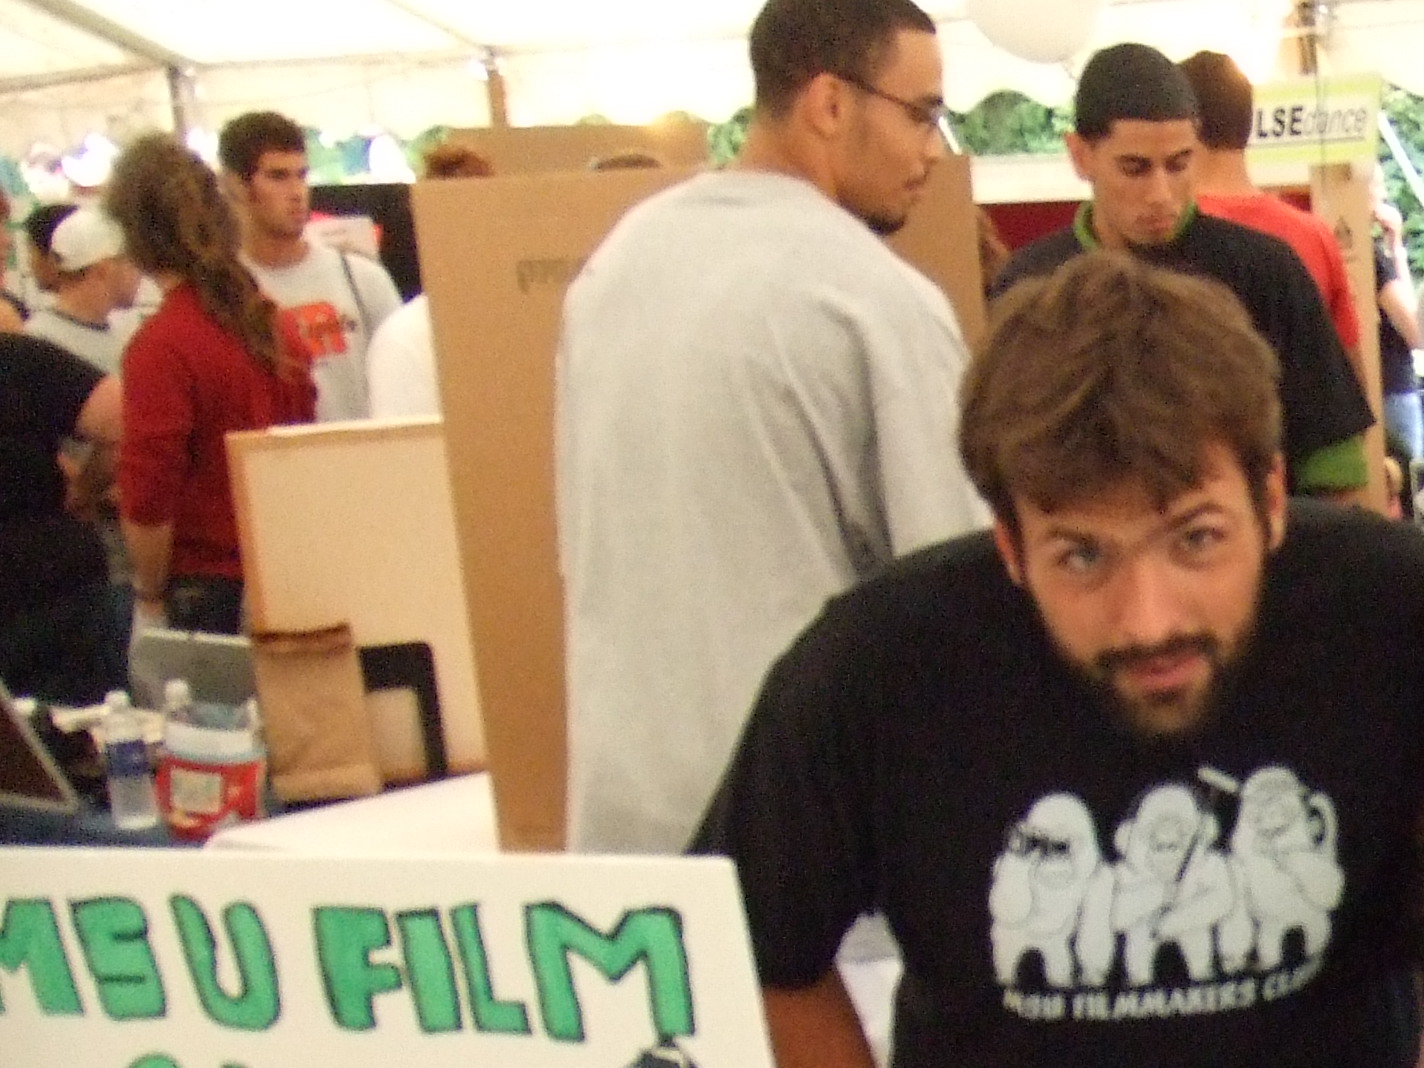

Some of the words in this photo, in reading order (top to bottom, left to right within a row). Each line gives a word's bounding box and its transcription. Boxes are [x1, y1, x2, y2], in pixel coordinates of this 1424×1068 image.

[1256, 104, 1368, 138] LSEdance
[0, 893, 282, 1032] MSU
[310, 899, 697, 1043] FILM
